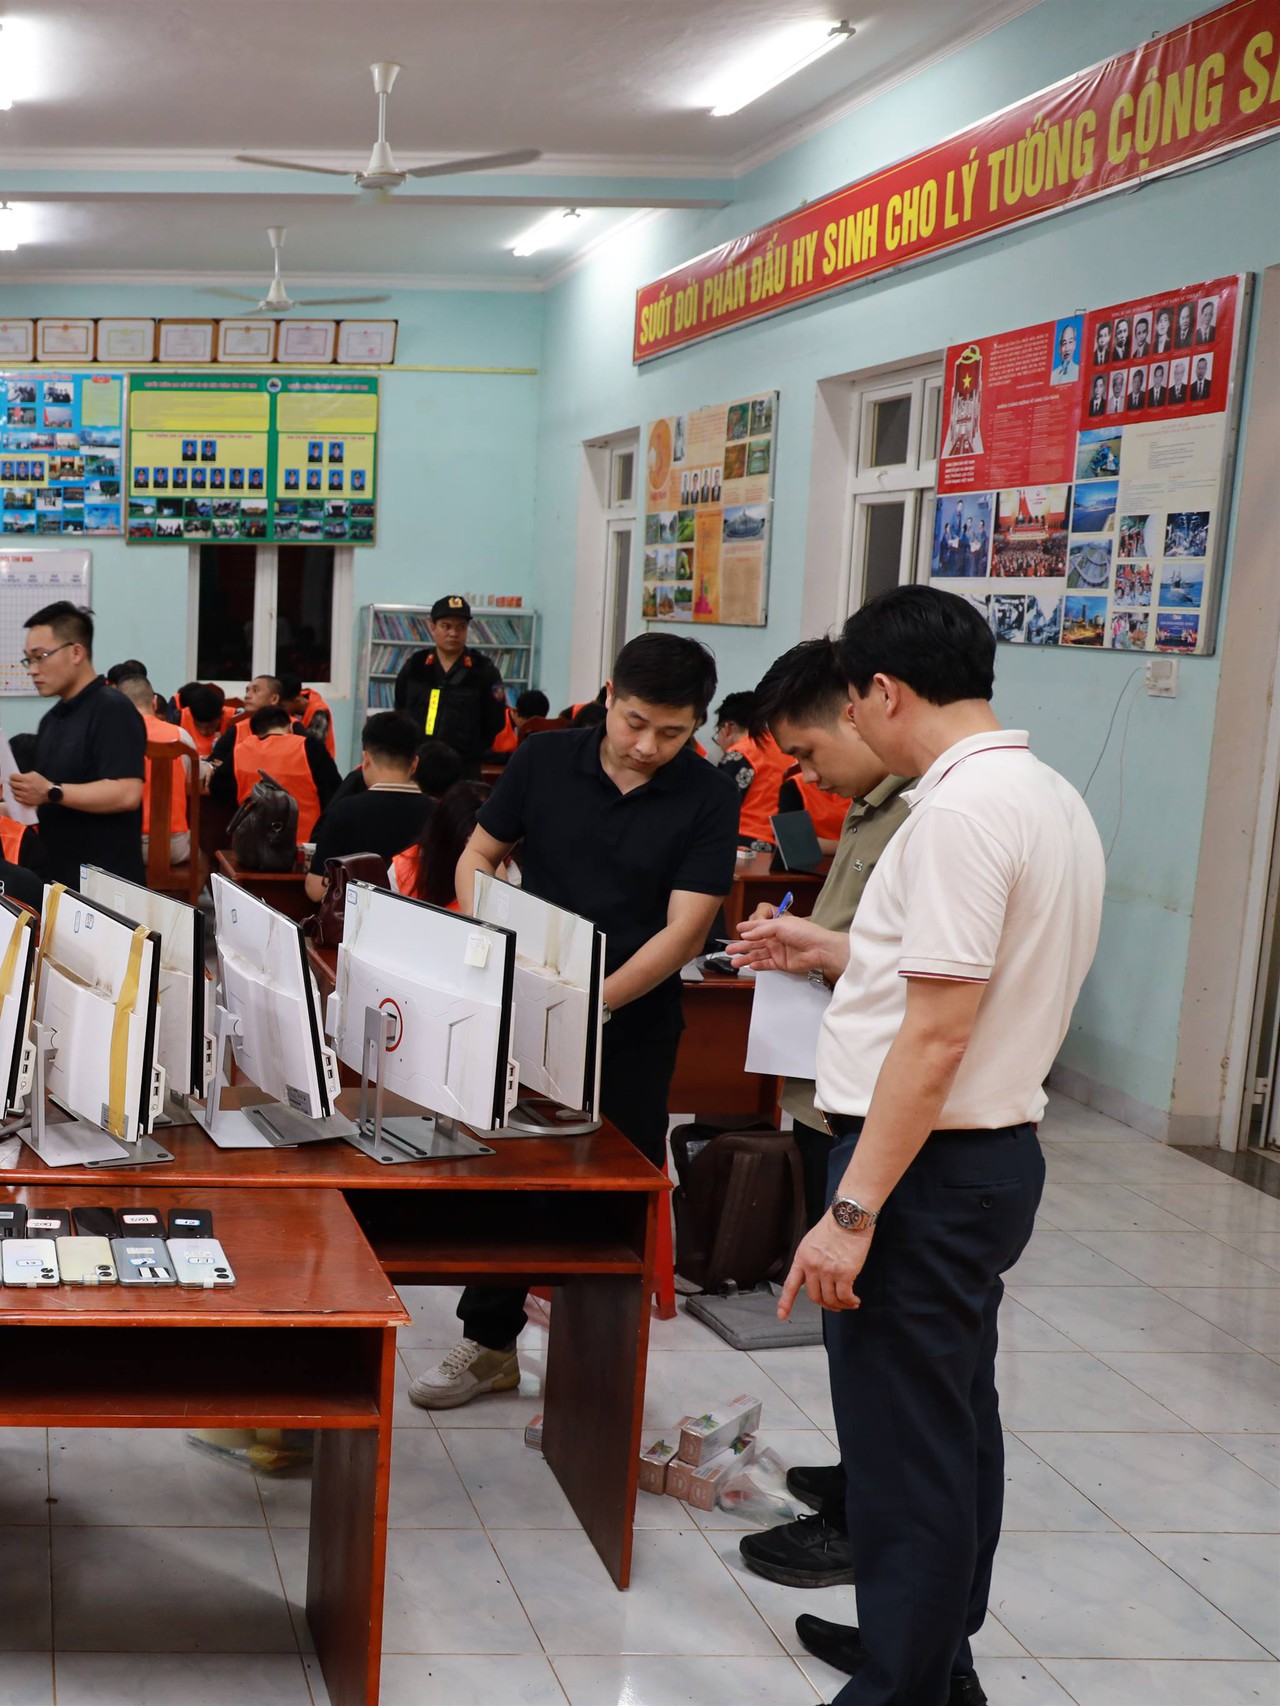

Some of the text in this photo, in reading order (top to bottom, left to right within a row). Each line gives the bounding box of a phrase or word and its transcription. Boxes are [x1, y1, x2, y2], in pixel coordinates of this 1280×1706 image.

[640, 283, 673, 346] SUỐT
[674, 276, 699, 333] ĐỜI
[750, 232, 788, 304] ĐẤU
[791, 229, 819, 288] HY
[822, 203, 880, 276] SINH
[885, 178, 938, 252] CHO
[944, 146, 979, 230] LÝ
[987, 110, 1097, 213] TƯỞNG
[1106, 51, 1226, 171] CỘNG
[1238, 30, 1280, 114] S
